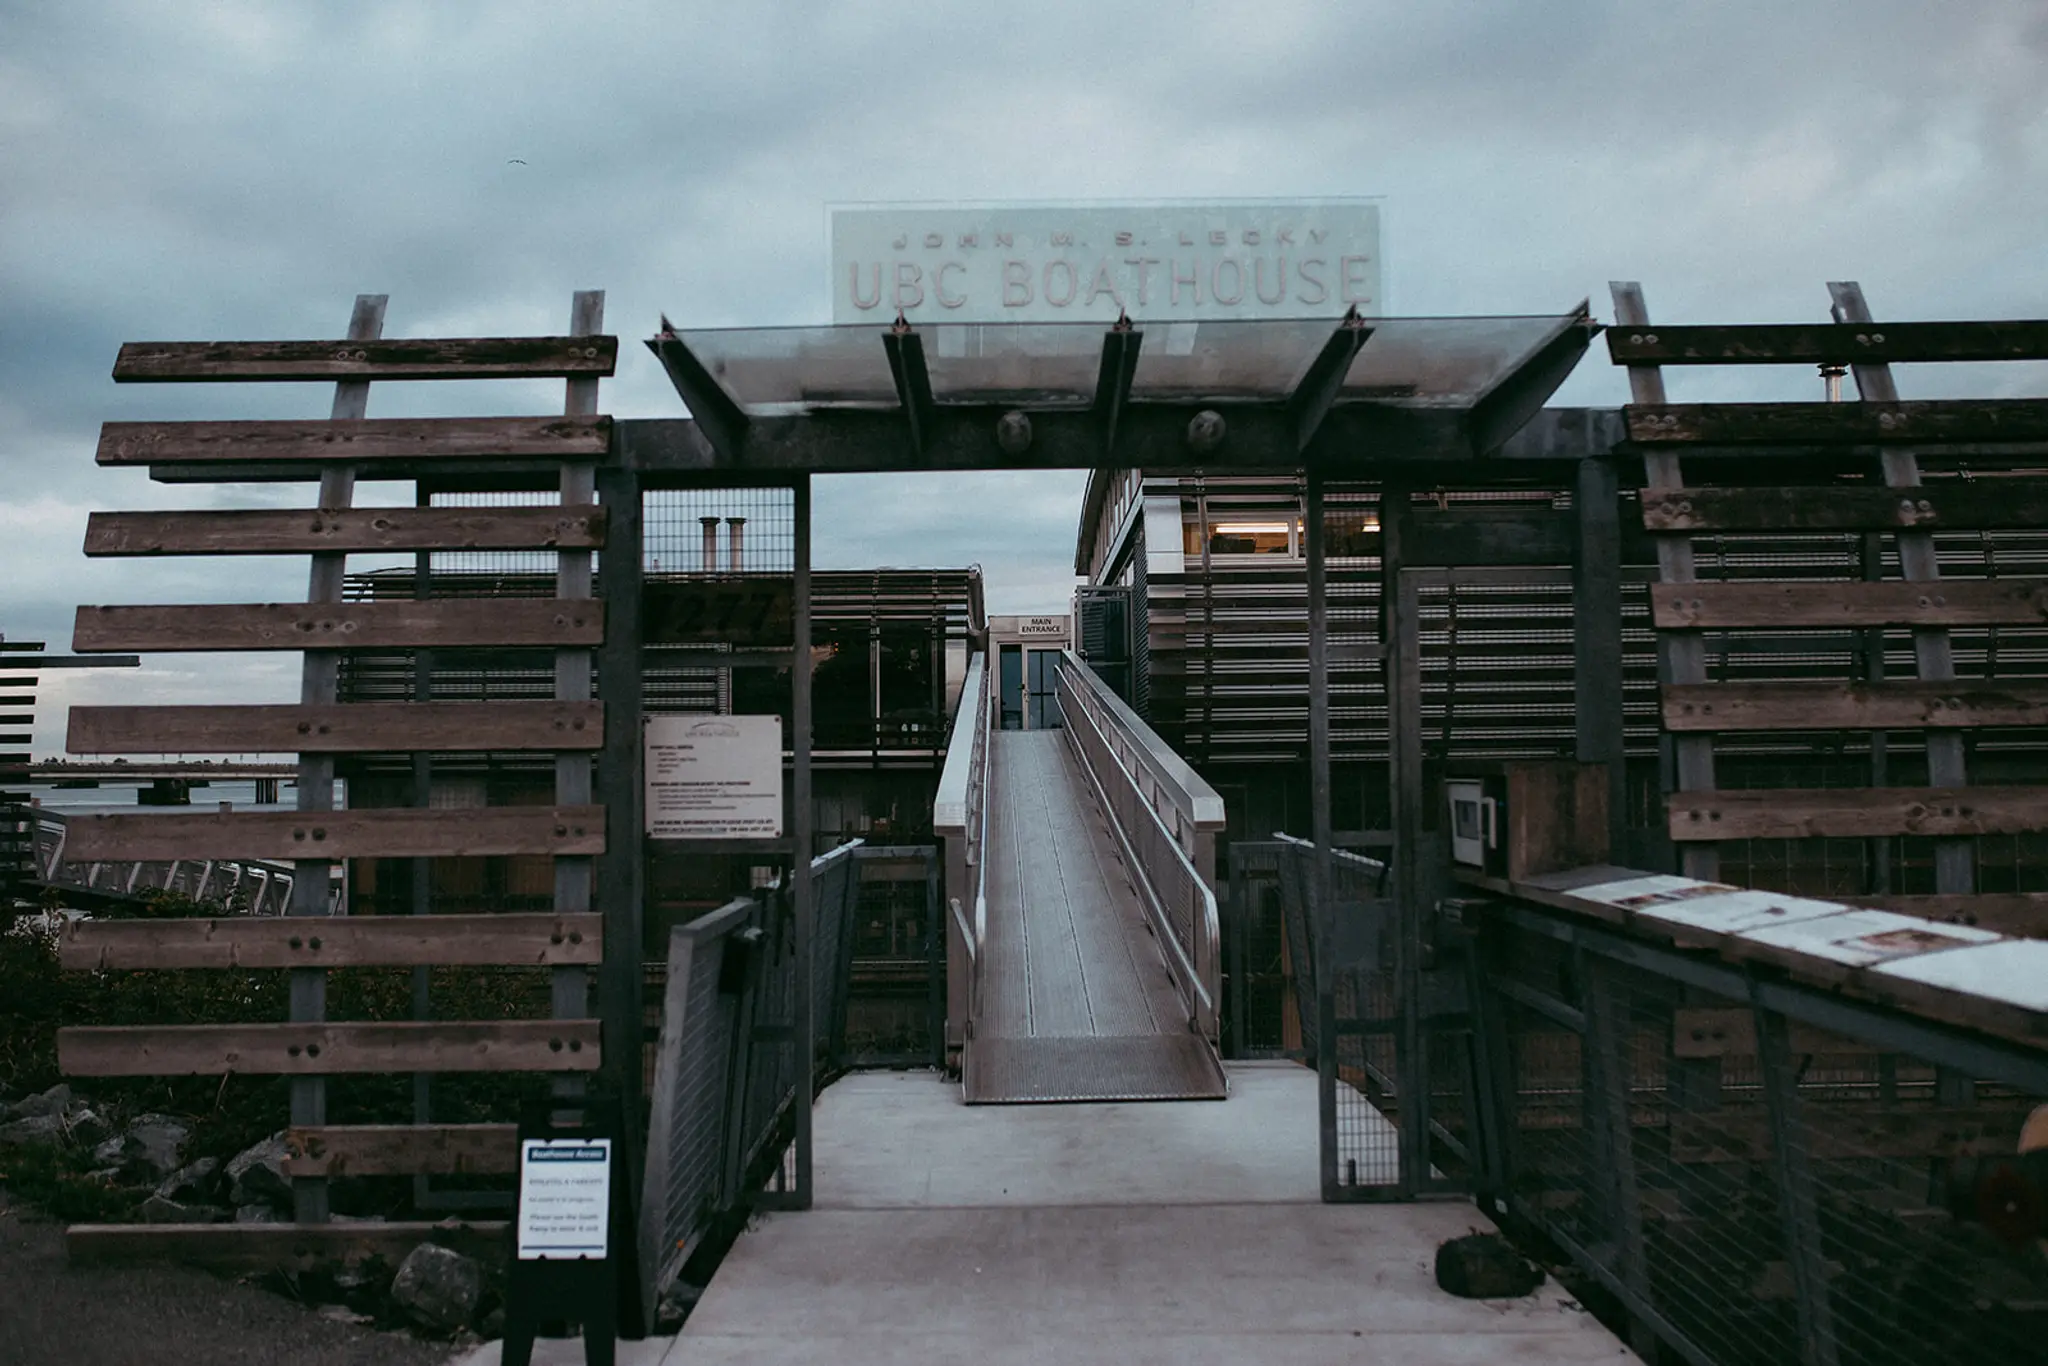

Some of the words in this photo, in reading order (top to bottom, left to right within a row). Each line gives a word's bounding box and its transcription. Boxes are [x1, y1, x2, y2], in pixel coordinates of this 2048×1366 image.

[892, 232, 1014, 250] JOHN
[1051, 232, 1087, 248] M.
[1115, 231, 1147, 247] S.
[1179, 229, 1328, 247] LECKY
[850, 261, 968, 310] UBC
[1002, 254, 1372, 308] BOATHOUSE
